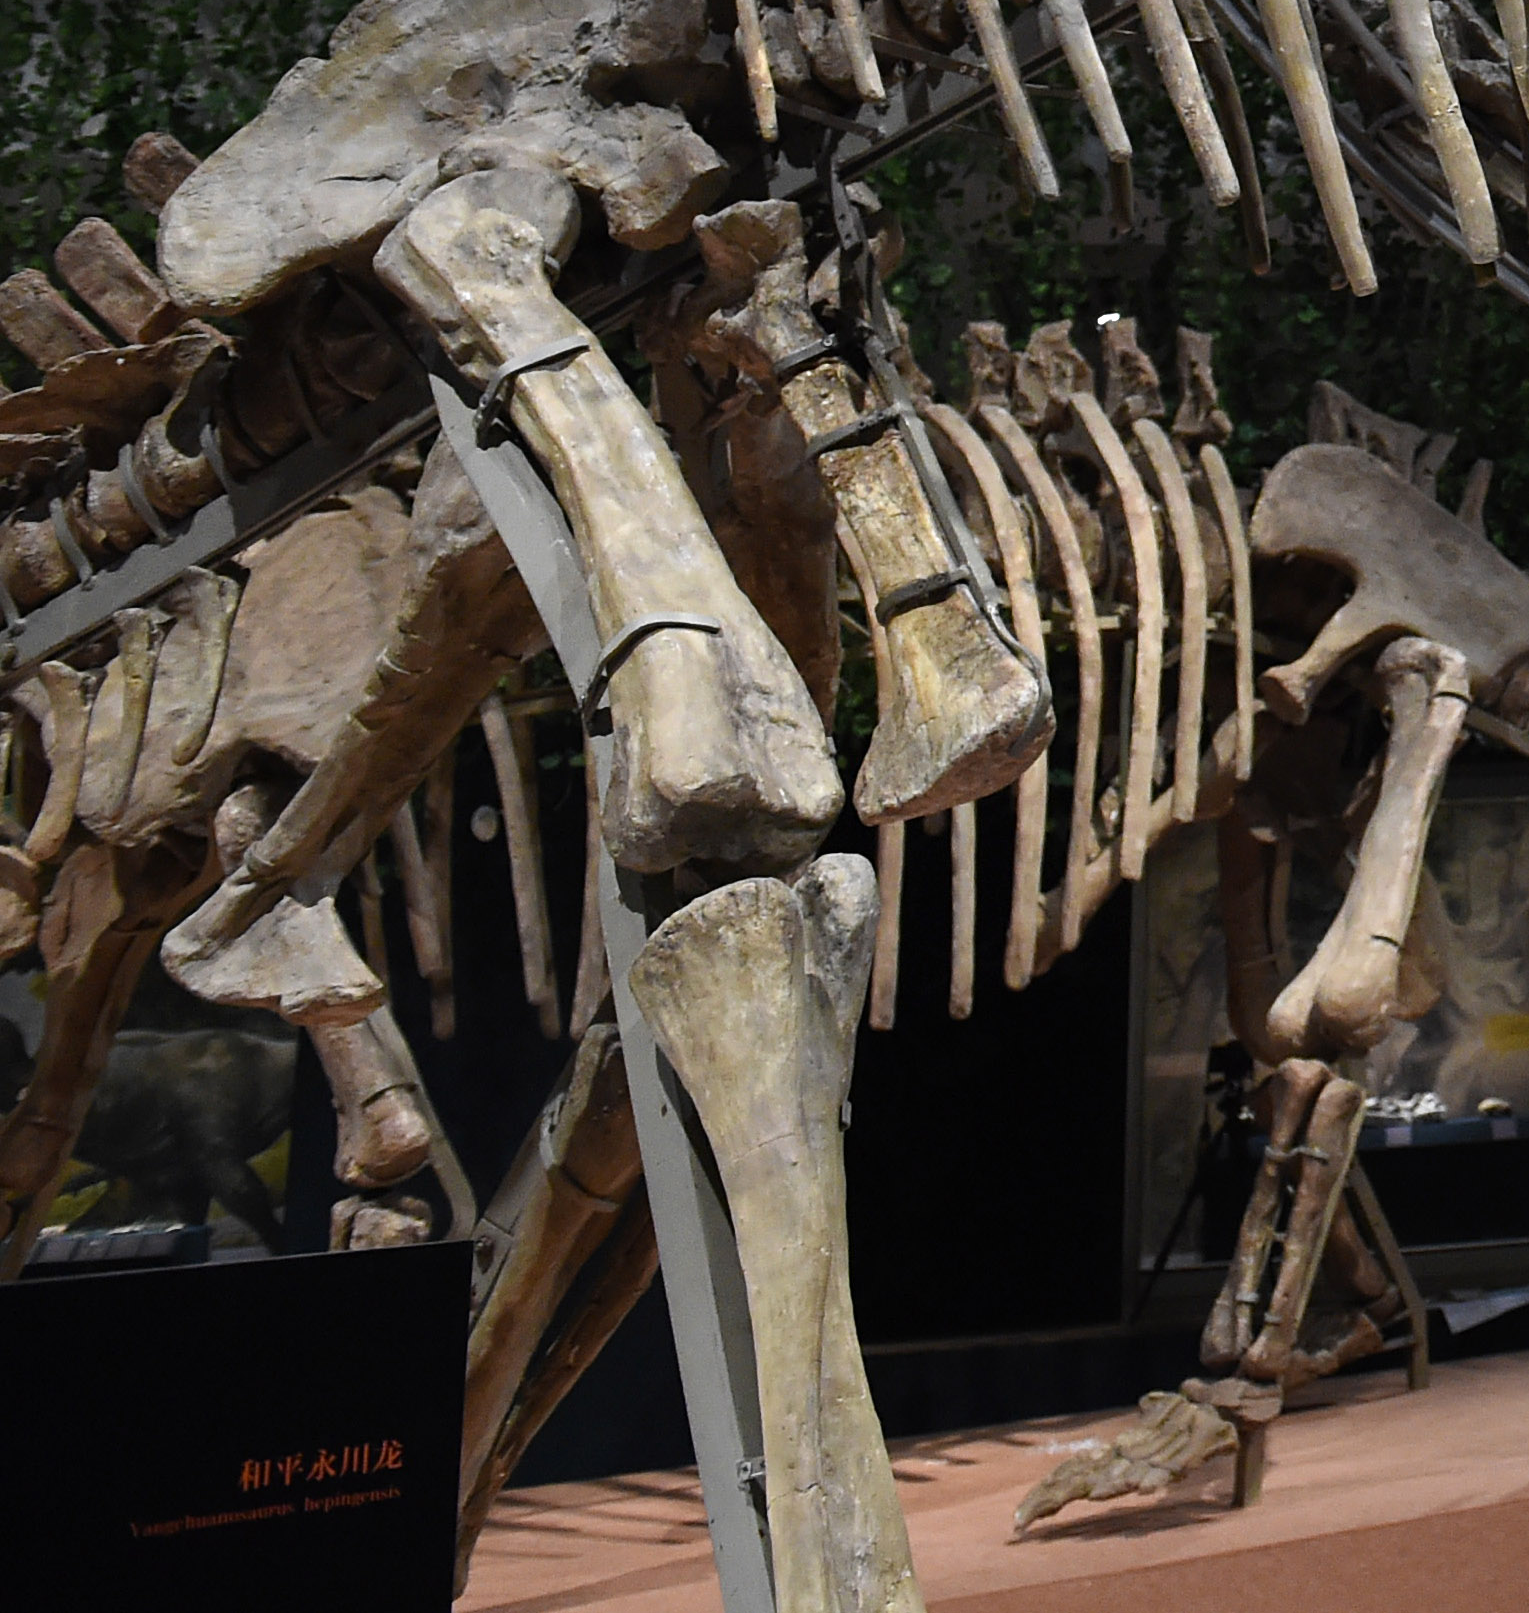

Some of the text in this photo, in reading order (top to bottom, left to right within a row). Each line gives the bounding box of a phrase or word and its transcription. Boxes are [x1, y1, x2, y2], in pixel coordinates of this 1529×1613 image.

[240, 1439, 404, 1492] 和平永川龙
[303, 1484, 401, 1513] hepingensis
